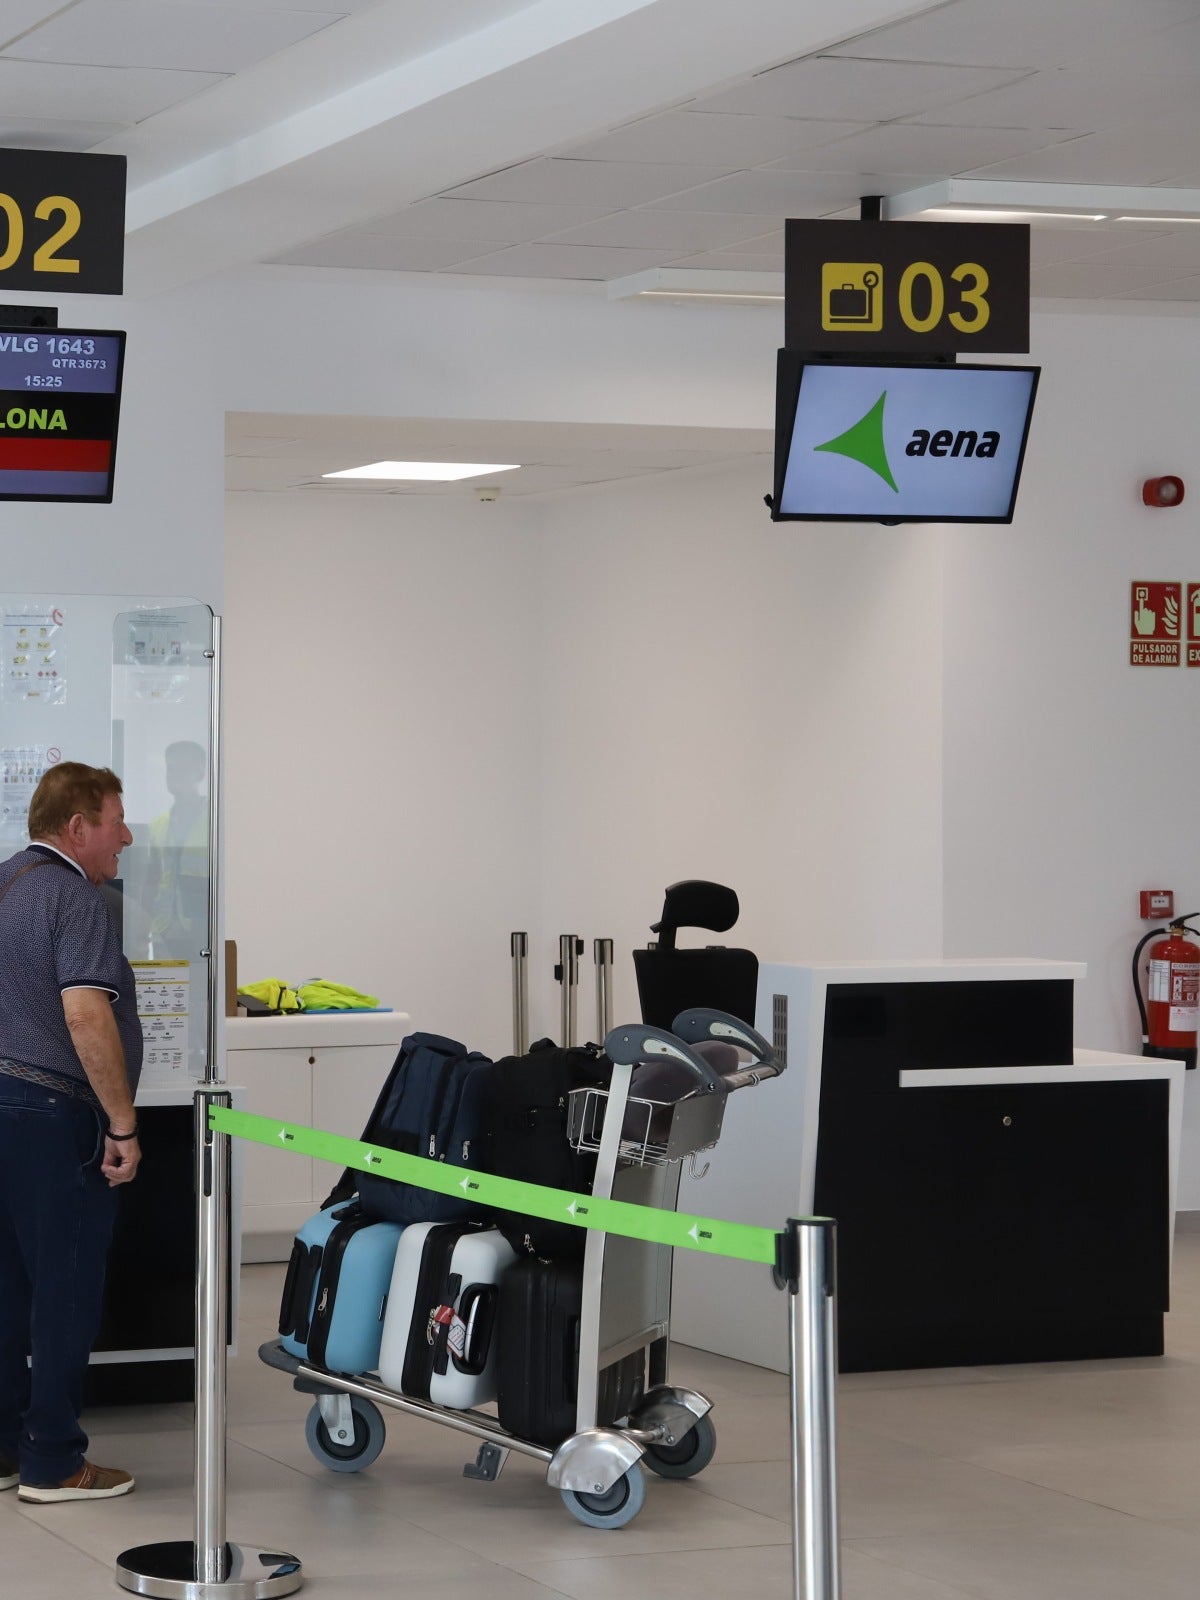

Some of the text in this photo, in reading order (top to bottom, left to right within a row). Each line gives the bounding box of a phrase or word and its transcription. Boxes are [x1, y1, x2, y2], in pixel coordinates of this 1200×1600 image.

[898, 261, 991, 334] 03
[46, 338, 96, 355] 1643
[52, 358, 107, 370] QTR3673
[24, 375, 63, 388] 15:25
[905, 428, 1001, 458] aena
[1133, 643, 1178, 654] PULSADOR
[1133, 654, 1178, 664] DE ALARMA
